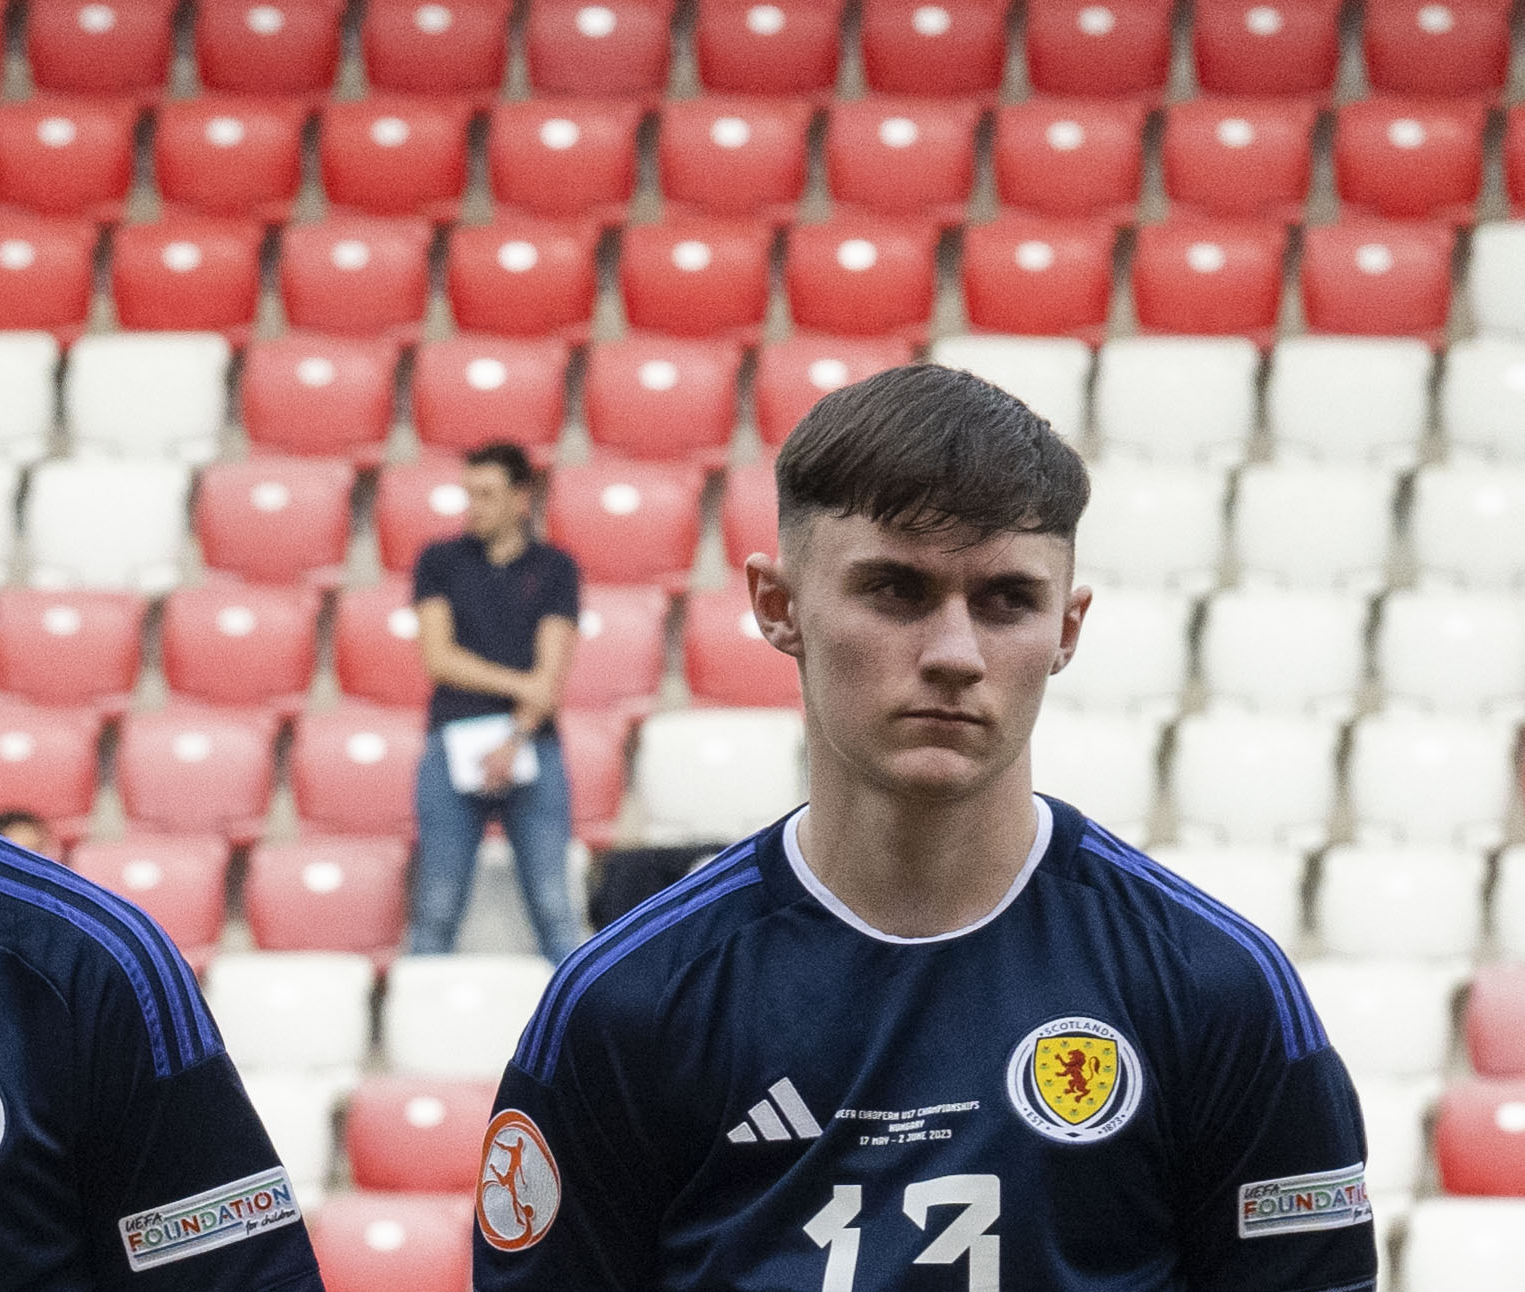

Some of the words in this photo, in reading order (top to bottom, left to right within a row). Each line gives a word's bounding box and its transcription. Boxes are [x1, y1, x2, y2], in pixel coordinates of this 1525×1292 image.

[1045, 1021, 1109, 1036] SCOTLAND
[858, 1110, 900, 1121] EUROPEAN
[917, 1101, 980, 1117] CHAMPIONSHIPS
[888, 1119, 925, 1132] HUNGARY
[1026, 1112, 1044, 1127] EST
[1102, 1116, 1123, 1133] 1873
[125, 1212, 163, 1232] UEFA
